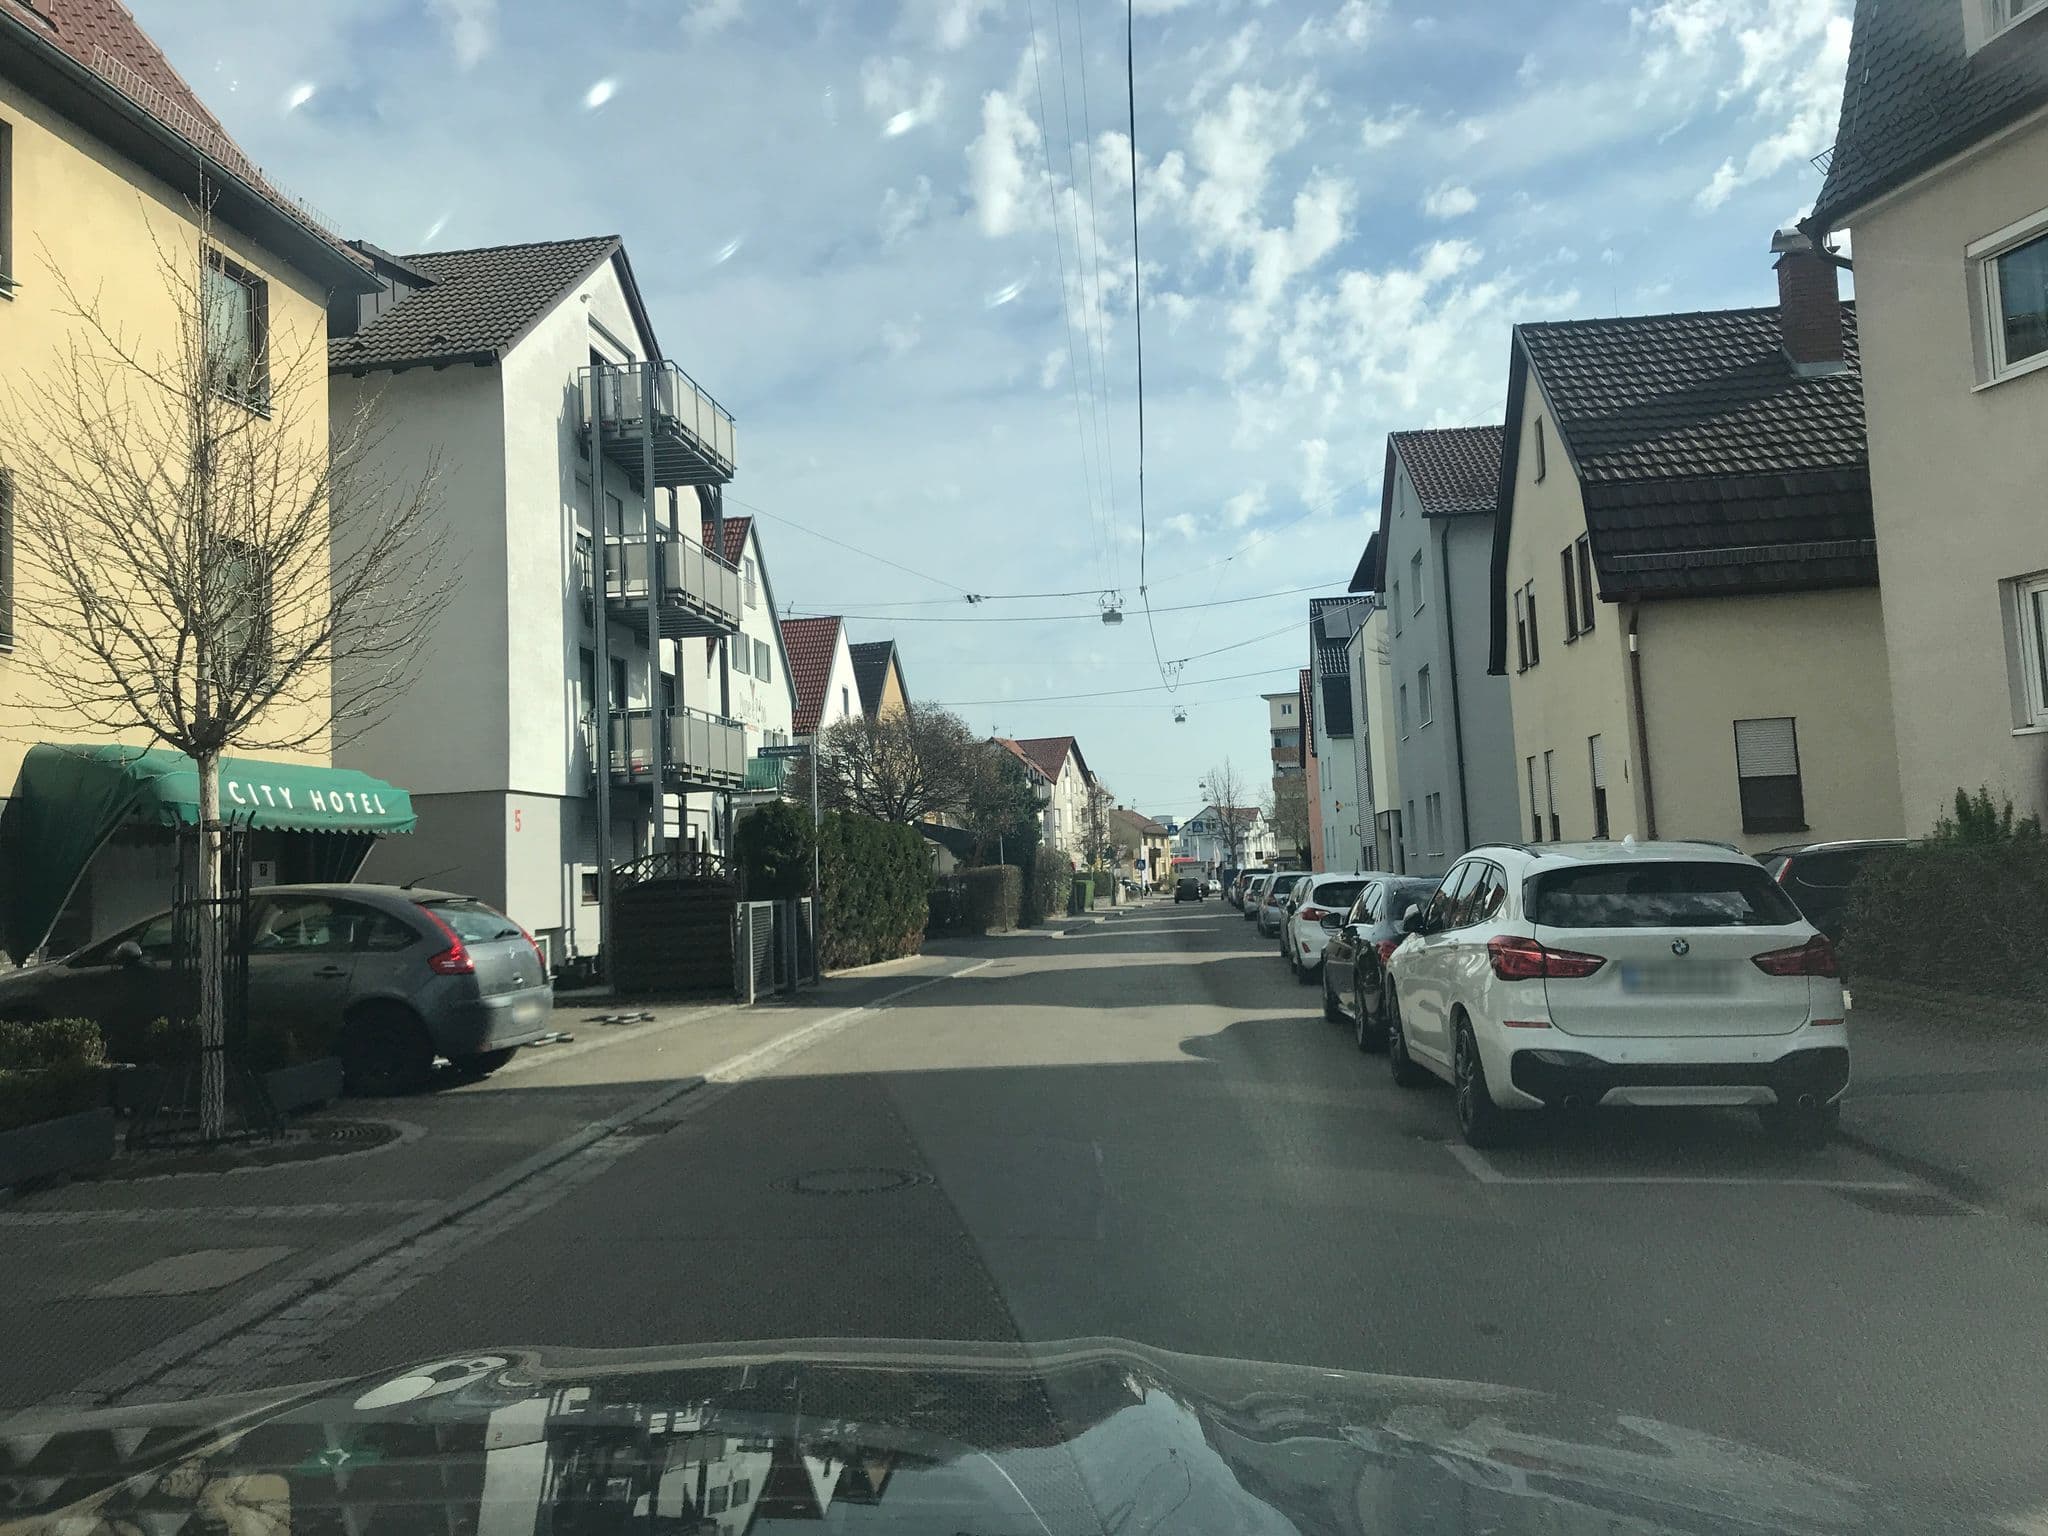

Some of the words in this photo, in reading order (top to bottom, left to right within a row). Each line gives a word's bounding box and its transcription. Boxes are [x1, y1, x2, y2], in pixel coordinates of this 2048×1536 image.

[228, 781, 293, 809] CITY
[310, 789, 386, 814] HOTEL
[514, 809, 521, 832] 5
